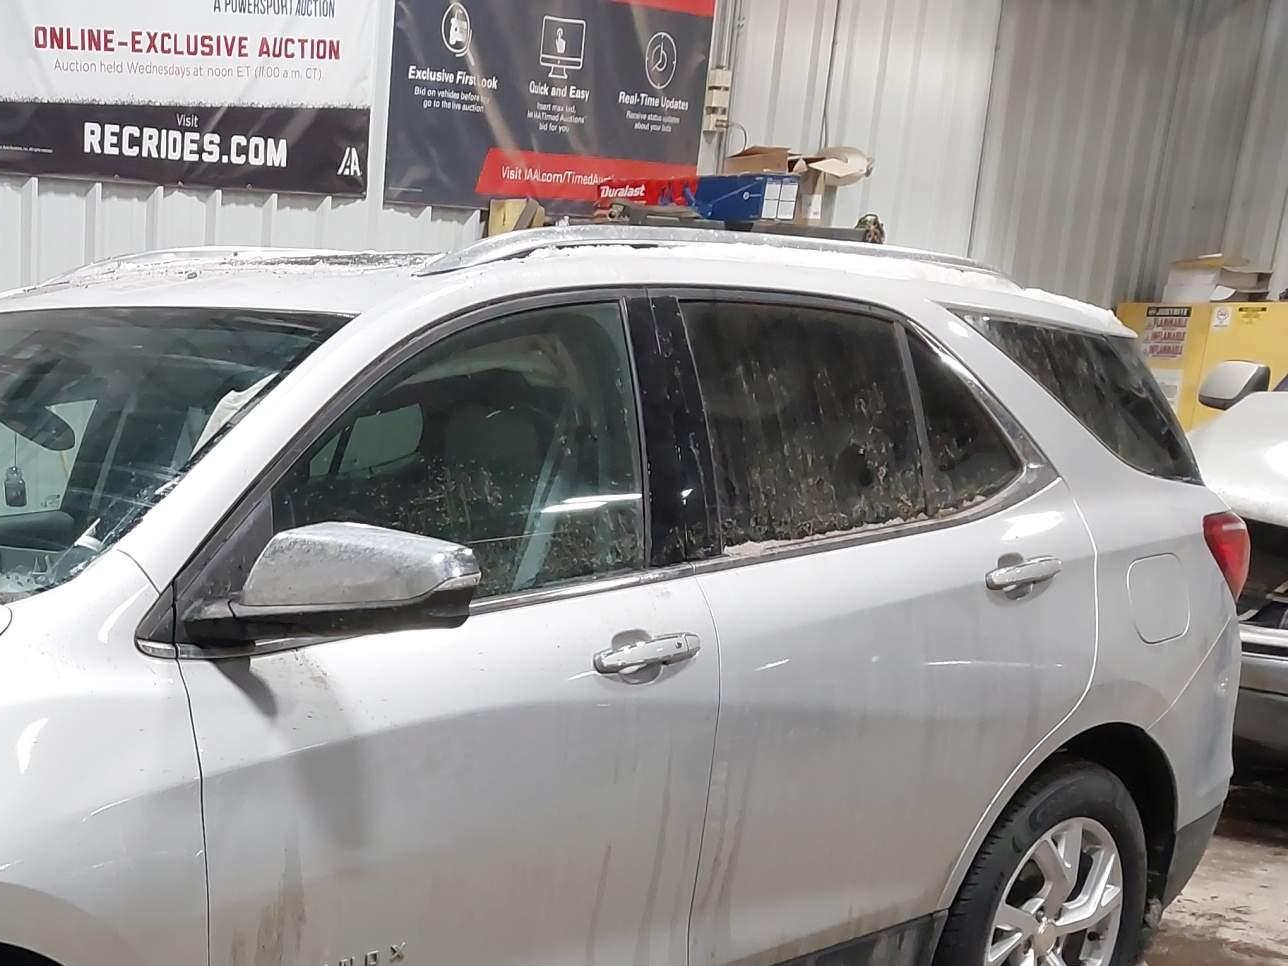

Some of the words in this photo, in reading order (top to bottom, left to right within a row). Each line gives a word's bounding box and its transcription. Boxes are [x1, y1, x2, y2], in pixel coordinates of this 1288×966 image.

[295, 0, 336, 18] AUCTION
[34, 26, 249, 57] ONLINE-EXCLUSIVE
[258, 37, 341, 60] AUCTION
[54, 58, 97, 73] Auction
[100, 60, 123, 74] held
[127, 61, 191, 78] Wednesdays
[193, 66, 203, 77] at
[207, 67, 234, 77] noon
[237, 66, 251, 78] ET
[408, 65, 454, 84] Exclusive
[414, 86, 426, 96] Bid
[427, 89, 436, 97] on
[529, 80, 549, 96] Quick
[551, 85, 568, 97] and
[569, 86, 590, 103] Easy
[433, 99, 440, 108] to
[618, 91, 660, 107] Real-Time
[661, 96, 689, 111] Updates
[176, 113, 199, 128] Visit
[83, 121, 289, 169] RECRIDES.COM
[501, 166, 522, 180] Visit
[600, 184, 646, 198] Duralast
